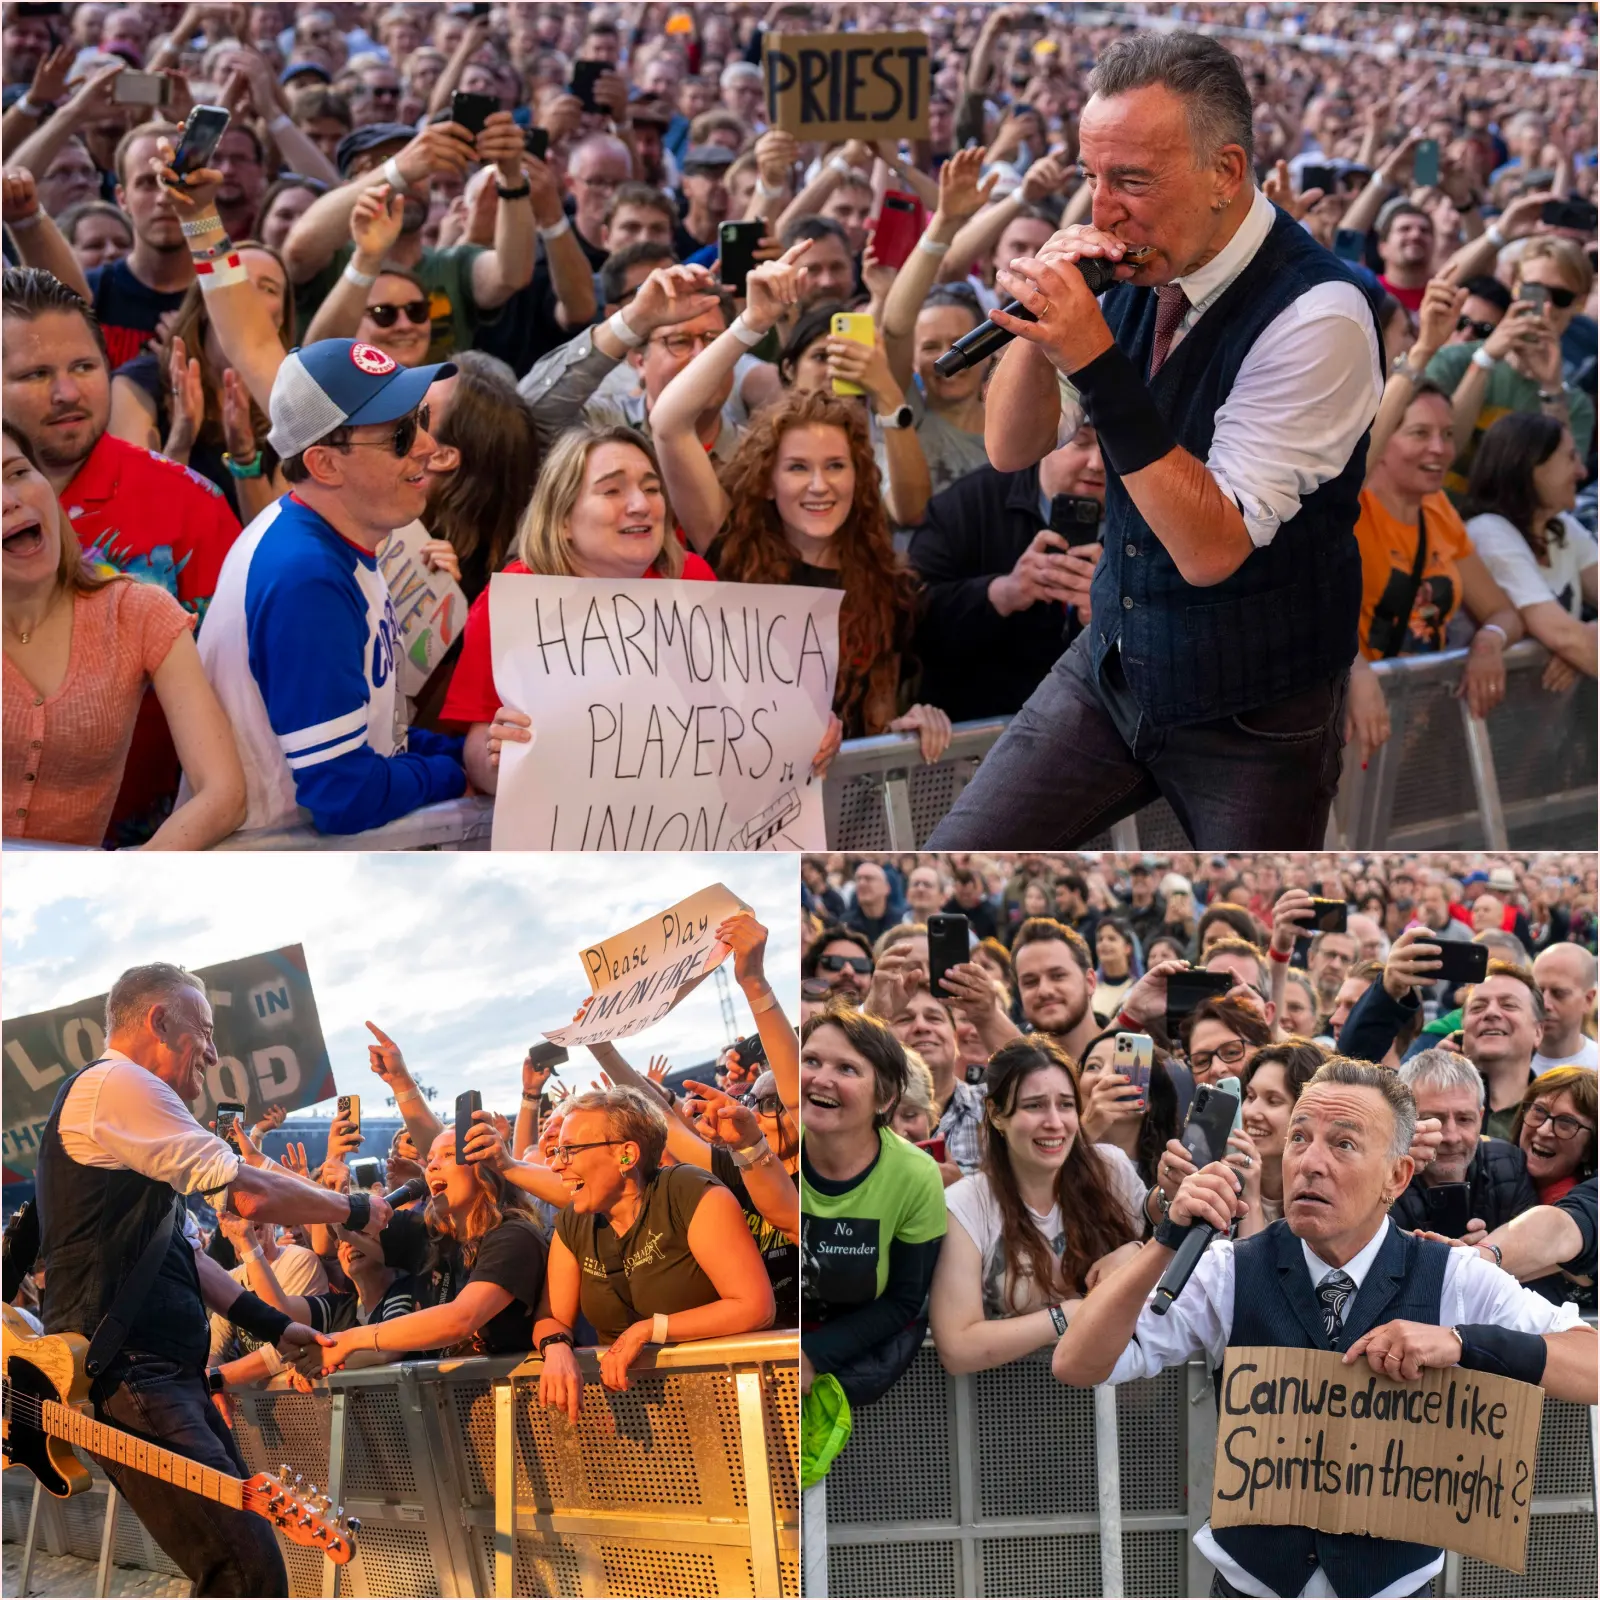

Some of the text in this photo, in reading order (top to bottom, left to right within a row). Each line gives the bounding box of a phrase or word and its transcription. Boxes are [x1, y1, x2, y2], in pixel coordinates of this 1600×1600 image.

[767, 46, 927, 123] PRIEST
[536, 593, 828, 692] HARMONICA
[588, 700, 778, 780] PLAYERS'
[550, 802, 728, 851] UNION
[585, 911, 709, 988] Please Play
[616, 970, 658, 1015] ON
[648, 945, 709, 1002] FIRE
[254, 986, 290, 1018] IN
[652, 1001, 673, 1022] D
[816, 1240, 876, 1255] Surrender
[834, 1222, 853, 1236] No
[1216, 1425, 1342, 1511] Spirits
